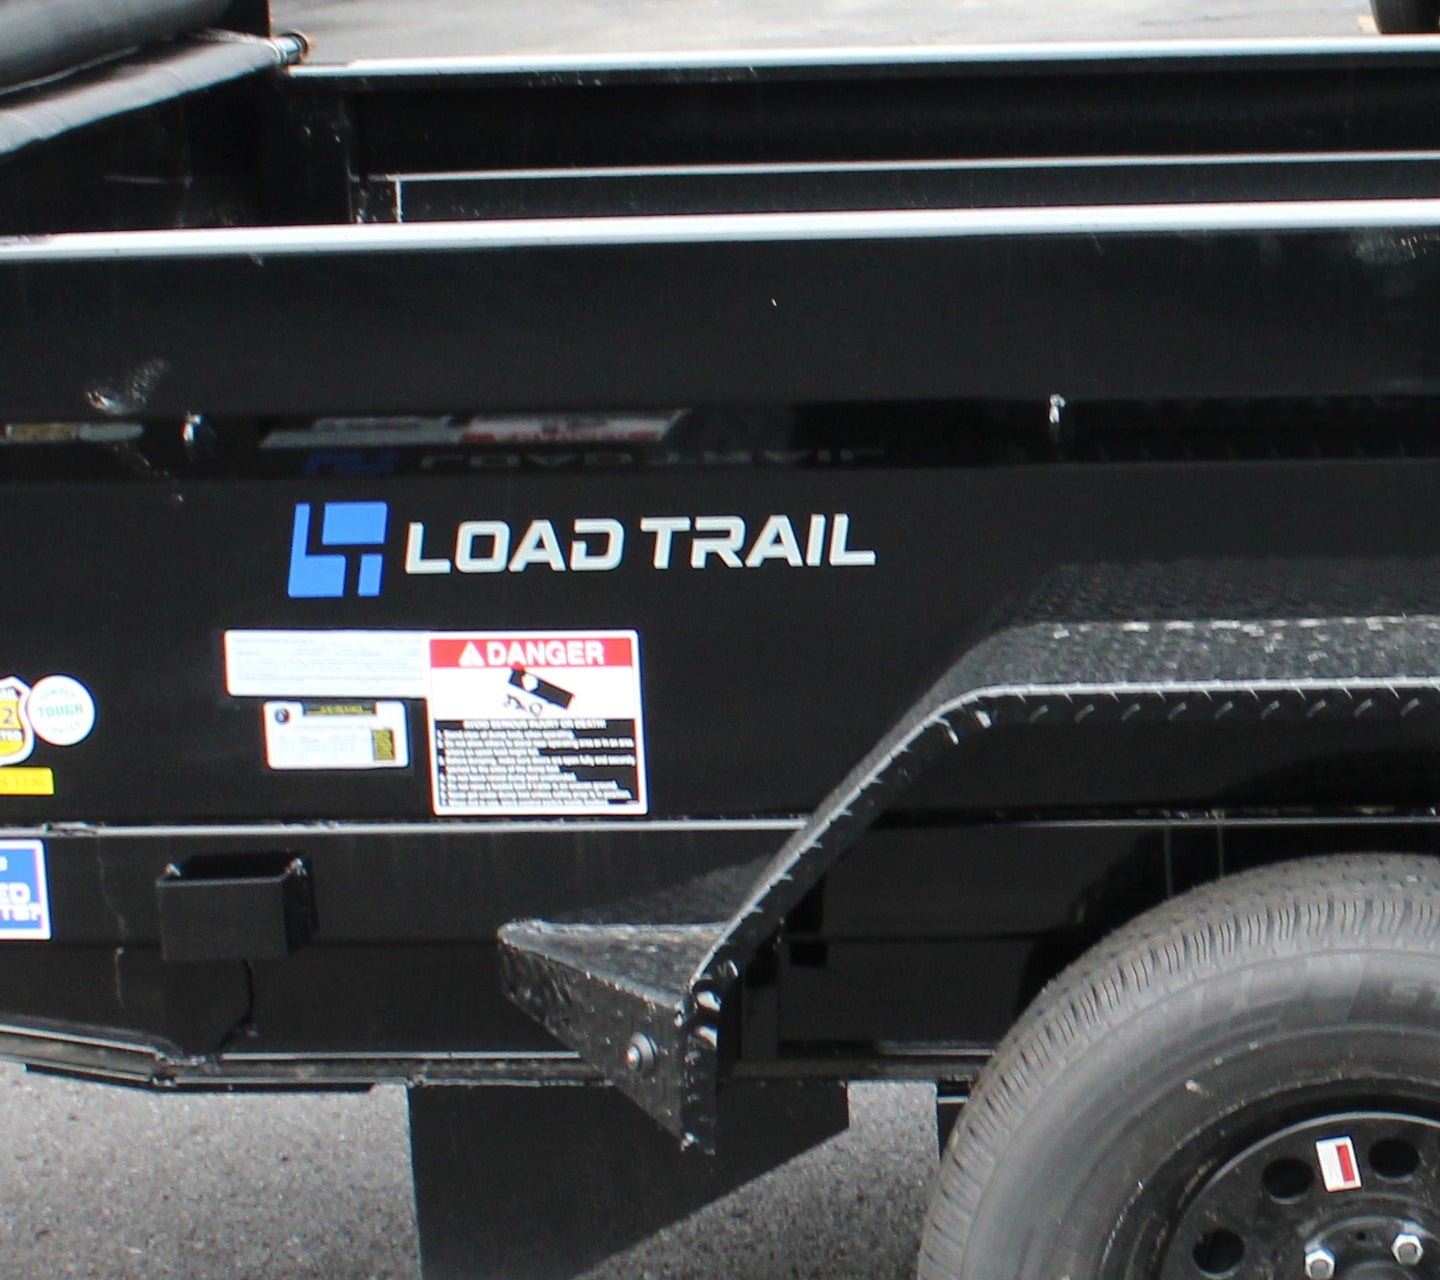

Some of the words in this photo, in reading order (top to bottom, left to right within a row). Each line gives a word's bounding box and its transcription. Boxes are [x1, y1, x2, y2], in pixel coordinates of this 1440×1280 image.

[404, 519, 626, 573] LOAD
[640, 513, 877, 569] TRAIL
[486, 640, 605, 666] DANGER
